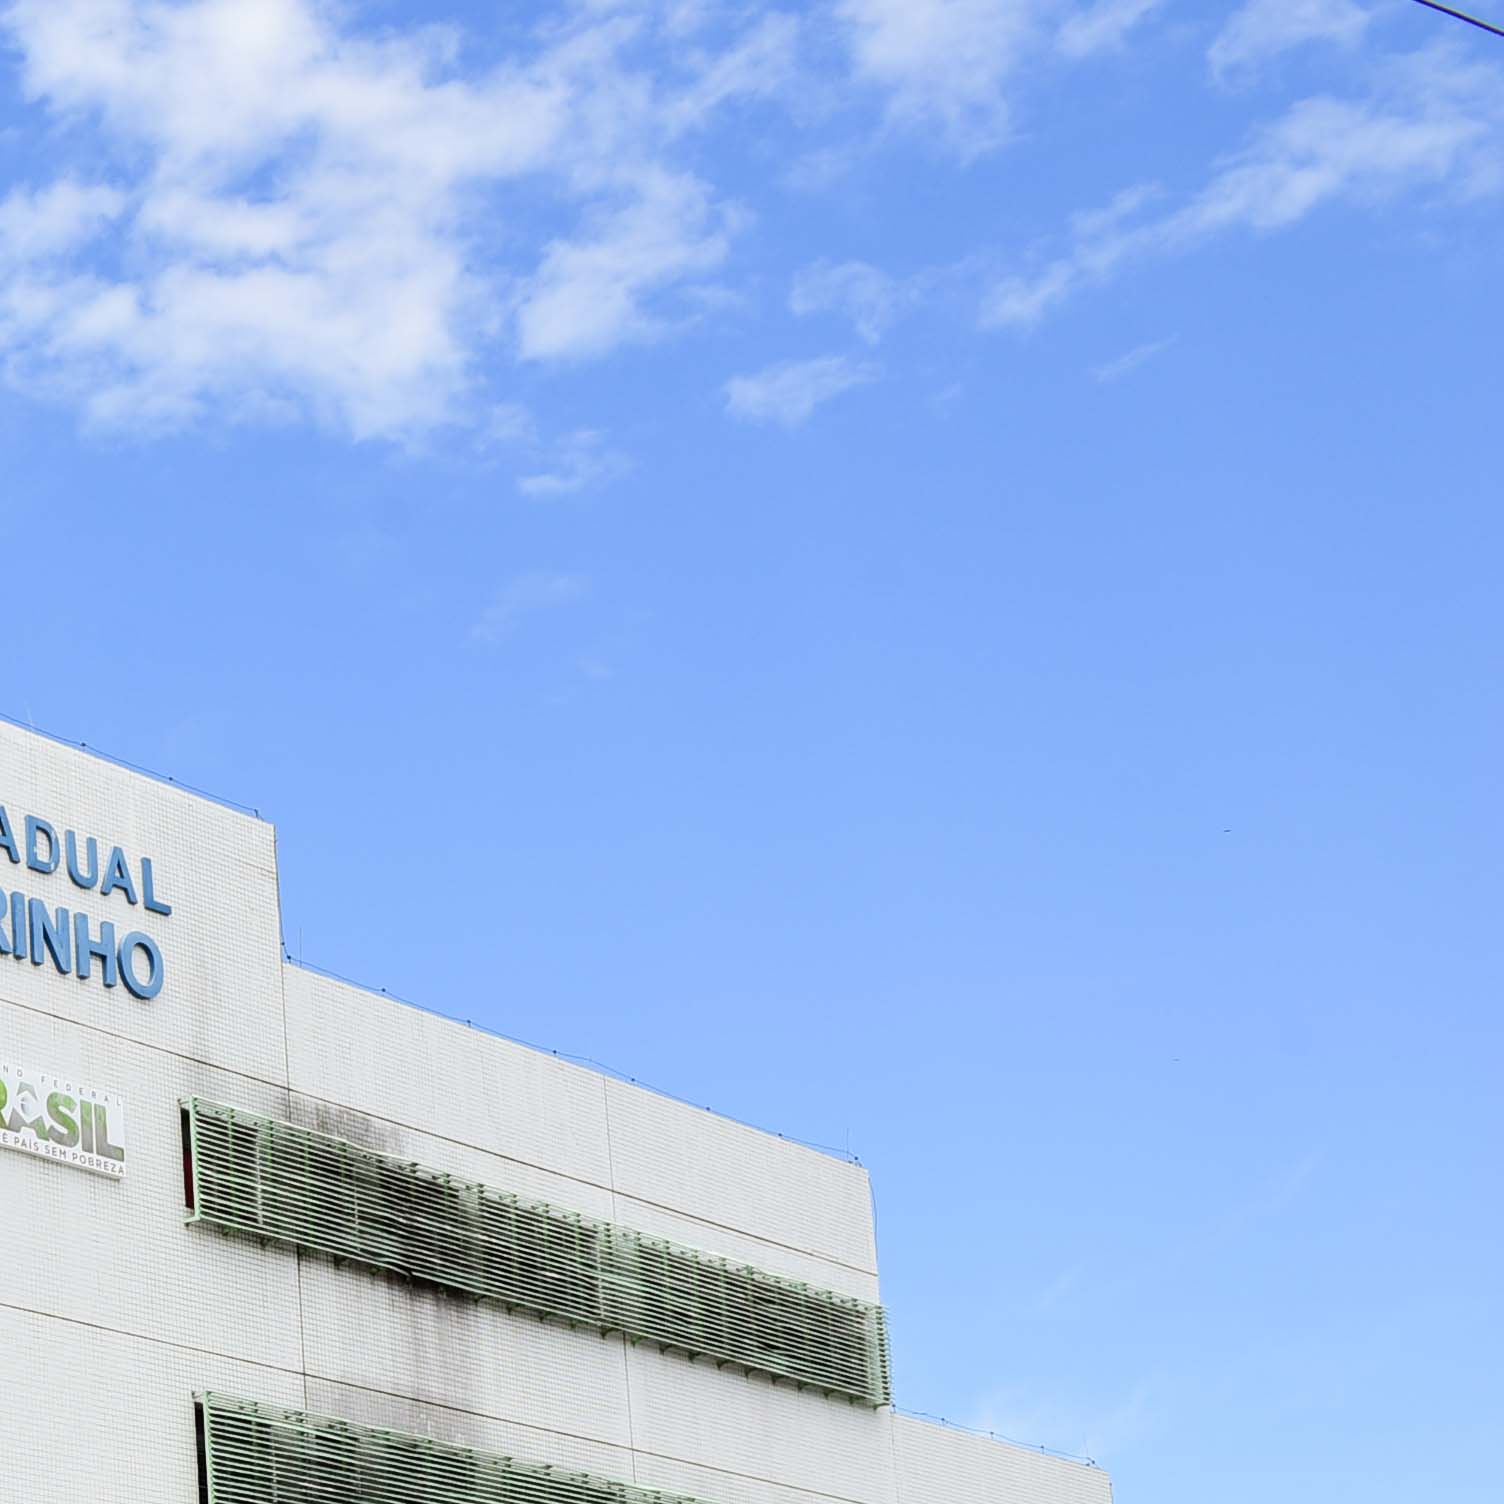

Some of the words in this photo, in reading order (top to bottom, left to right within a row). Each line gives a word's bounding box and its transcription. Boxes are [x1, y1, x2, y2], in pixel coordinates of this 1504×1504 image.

[41, 1076, 121, 1107] FEDERAL
[14, 1136, 39, 1152] PAÍS
[44, 1143, 67, 1159] SEM
[72, 1152, 124, 1175] POBREZA
